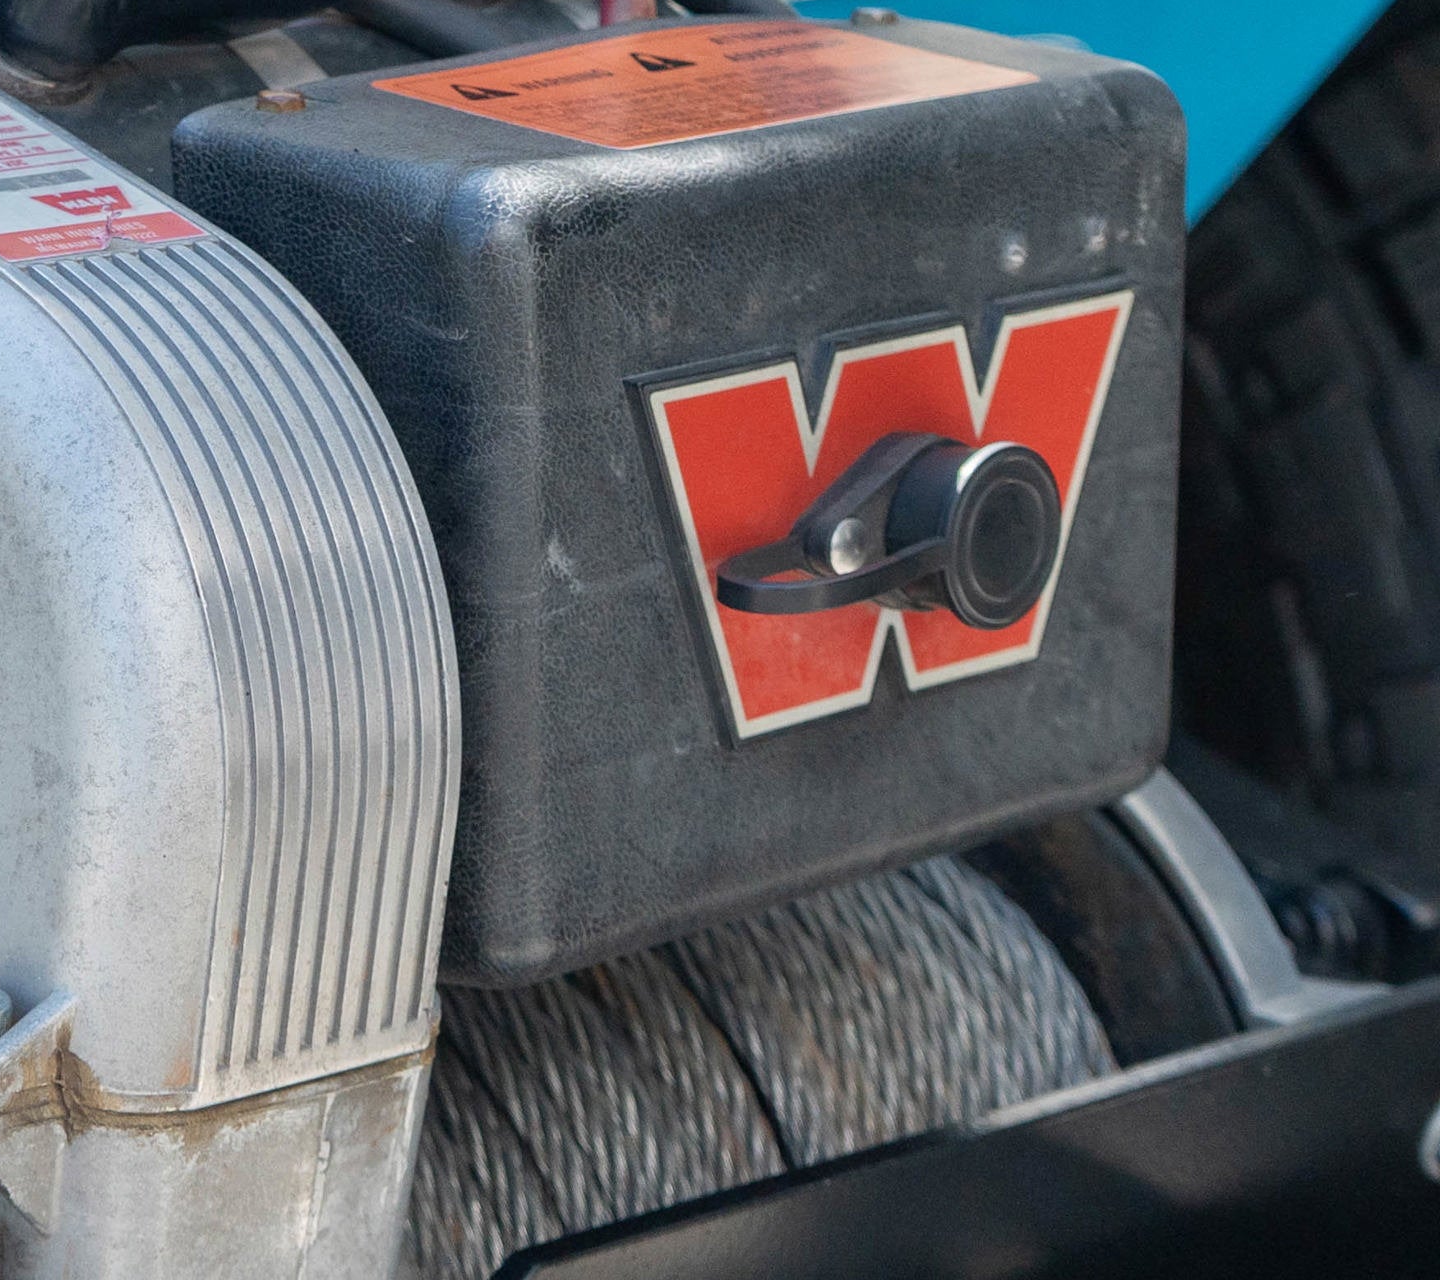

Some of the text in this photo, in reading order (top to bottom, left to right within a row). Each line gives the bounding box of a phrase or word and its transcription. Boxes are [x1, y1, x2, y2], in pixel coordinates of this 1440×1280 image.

[55, 193, 122, 209] WARN
[15, 231, 67, 244] WARN
[649, 289, 1135, 740] W
